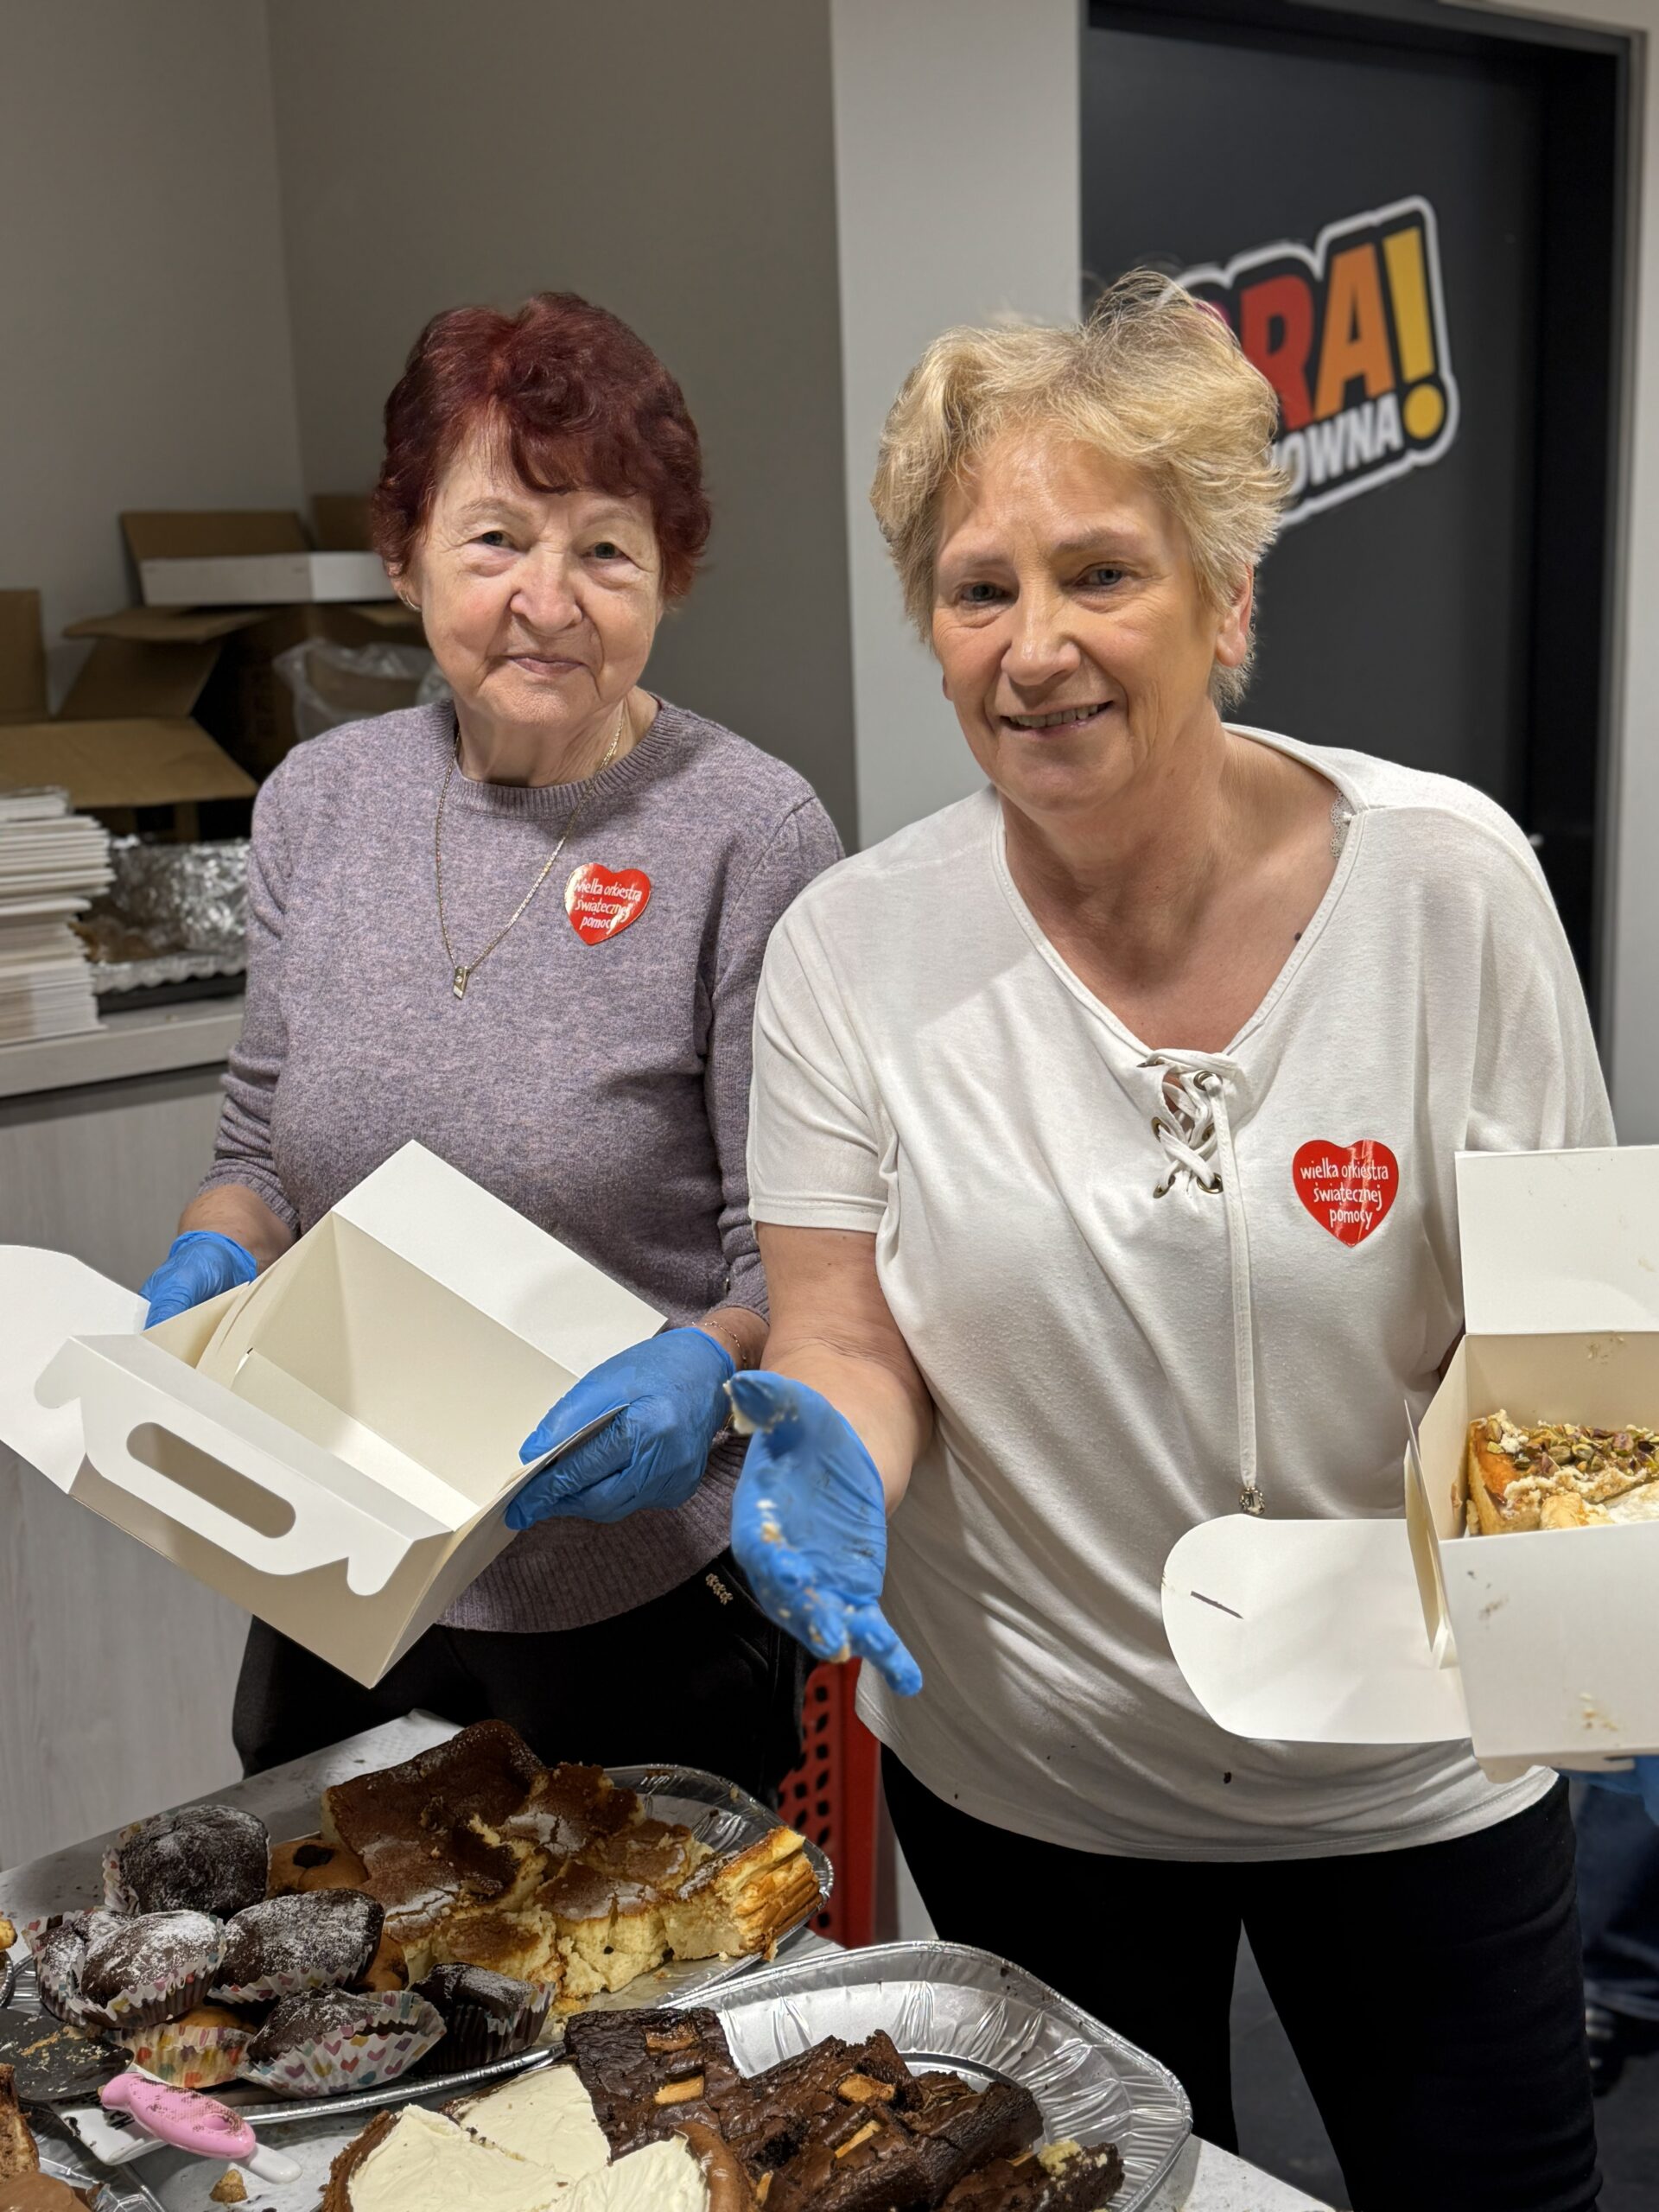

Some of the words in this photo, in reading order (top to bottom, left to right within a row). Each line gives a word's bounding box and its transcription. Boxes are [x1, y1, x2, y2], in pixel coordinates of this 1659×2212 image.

[1196, 226, 1445, 440] RA!
[1271, 393, 1403, 498] OWNA
[575, 878, 603, 895] wielka
[604, 882, 643, 902] orkiestra
[1300, 1157, 1339, 1179] wielka
[1341, 1159, 1389, 1180] orkiestra
[1313, 1181, 1382, 1211] świątecznej
[1329, 1208, 1373, 1230] pomocy
